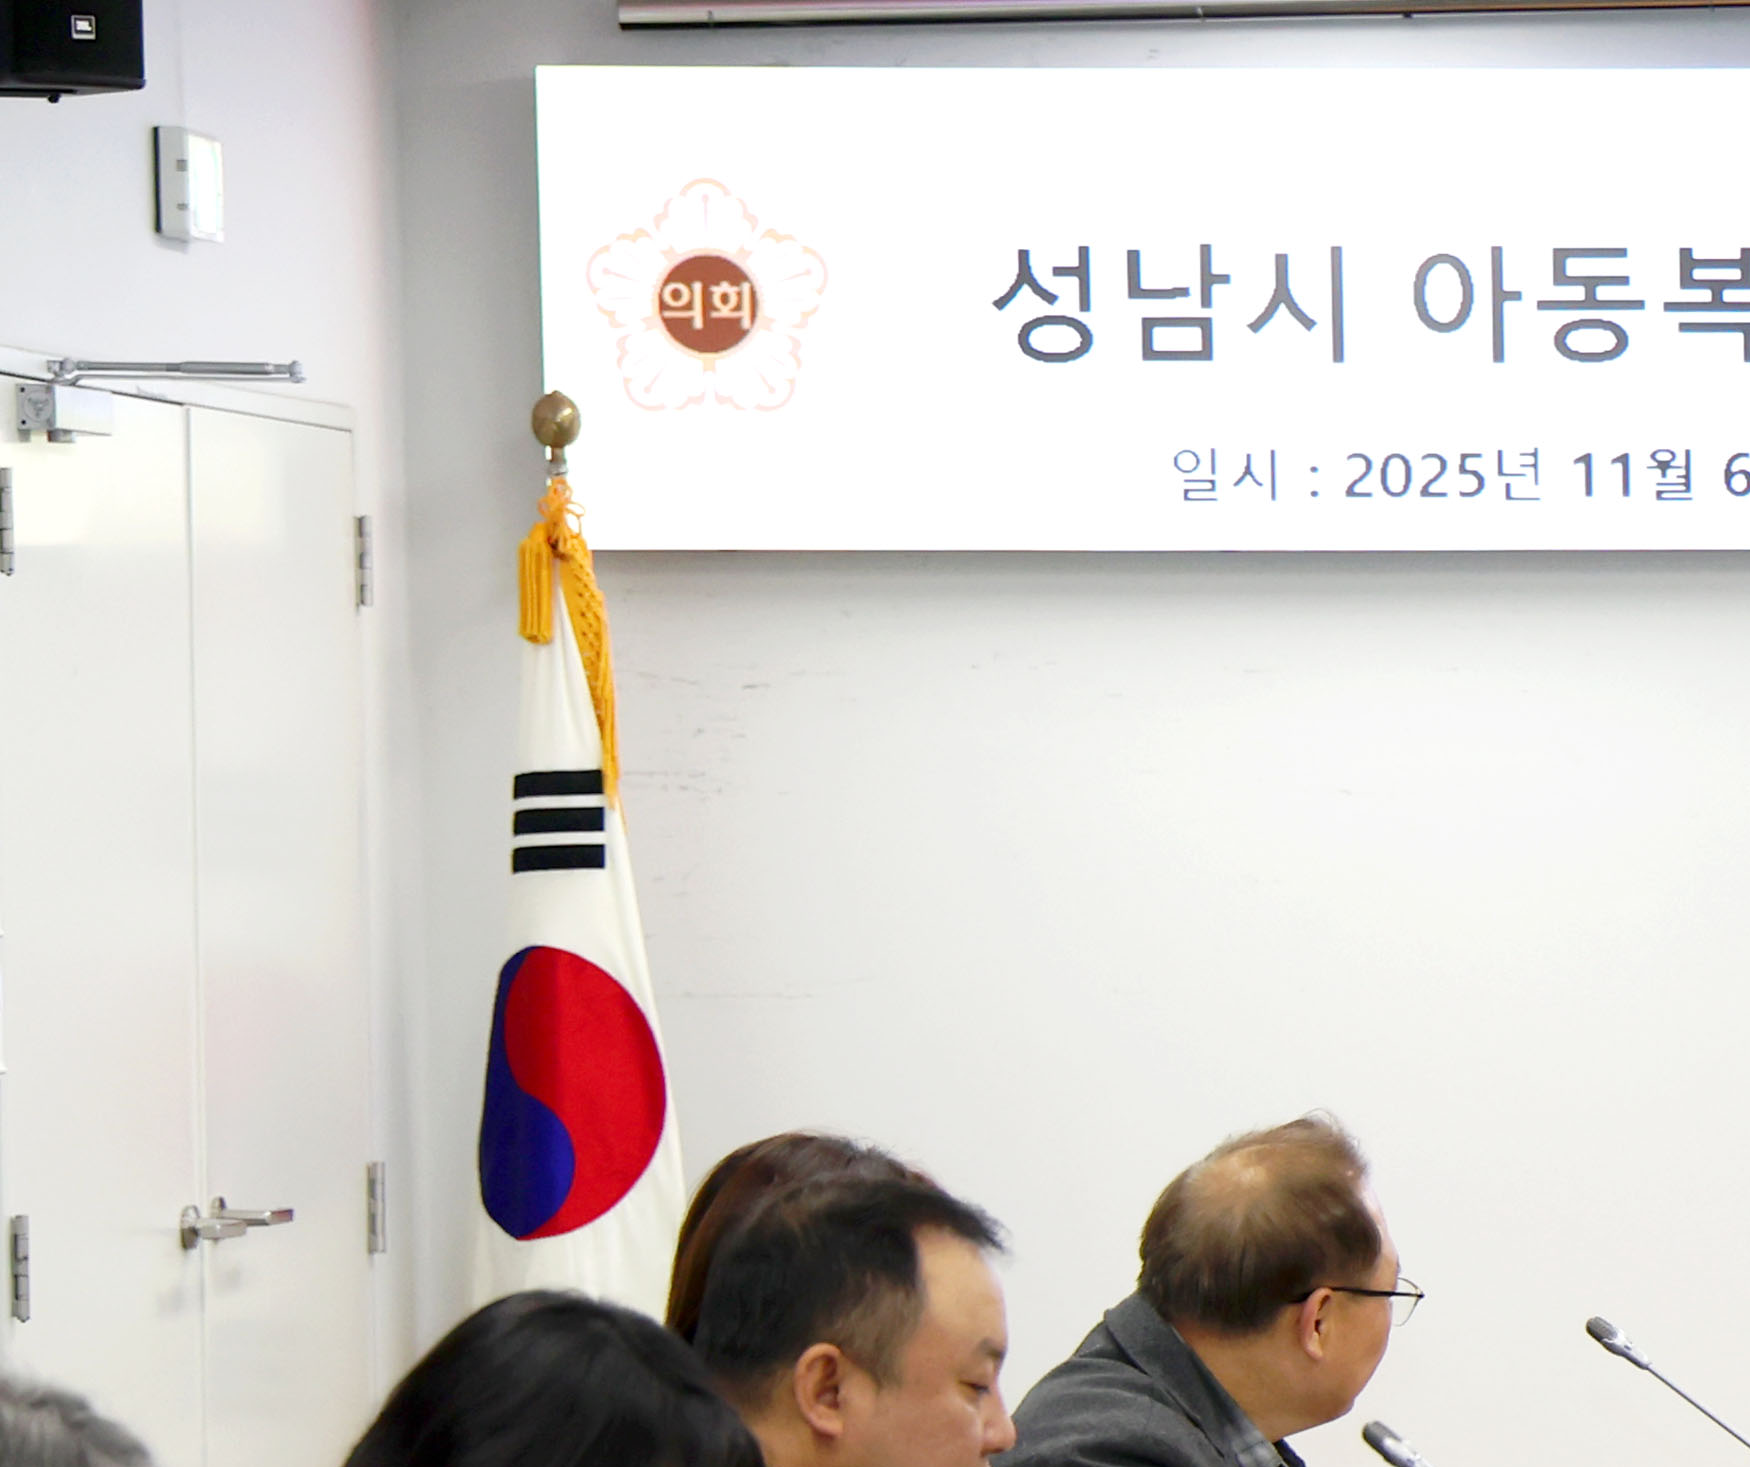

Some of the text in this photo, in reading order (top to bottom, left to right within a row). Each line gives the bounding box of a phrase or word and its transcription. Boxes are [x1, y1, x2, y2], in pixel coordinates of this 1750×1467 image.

[659, 280, 753, 330] 의회
[992, 244, 1345, 364] 성남시
[1173, 447, 1277, 502] 일시
[1309, 465, 1319, 498] :
[1344, 447, 1540, 501] 2025년
[1573, 448, 1693, 501] 11월
